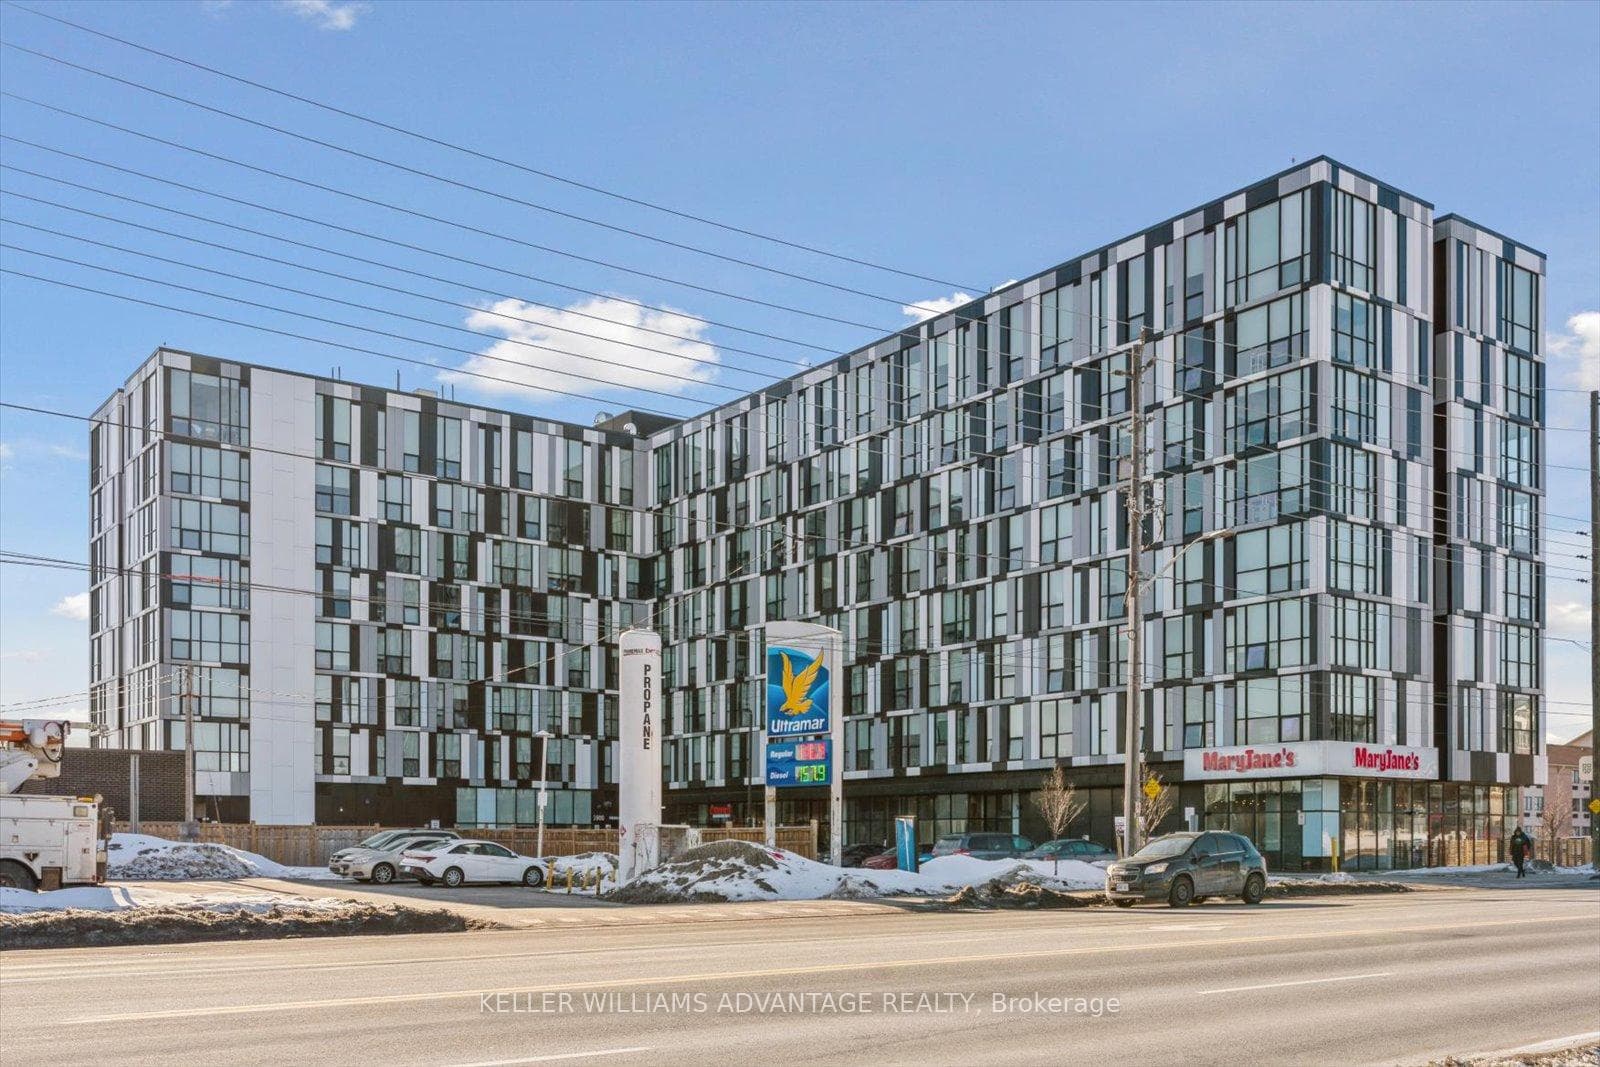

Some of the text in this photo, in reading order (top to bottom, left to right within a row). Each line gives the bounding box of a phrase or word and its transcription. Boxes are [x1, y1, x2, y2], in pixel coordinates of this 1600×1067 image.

[643, 664, 652, 750] PROPANE
[771, 718, 825, 733] Ultramar
[770, 750, 793, 759] Regular
[1203, 747, 1295, 773] MaryJane's
[1355, 747, 1419, 771] MaryJane's
[770, 771, 789, 779] Diesel
